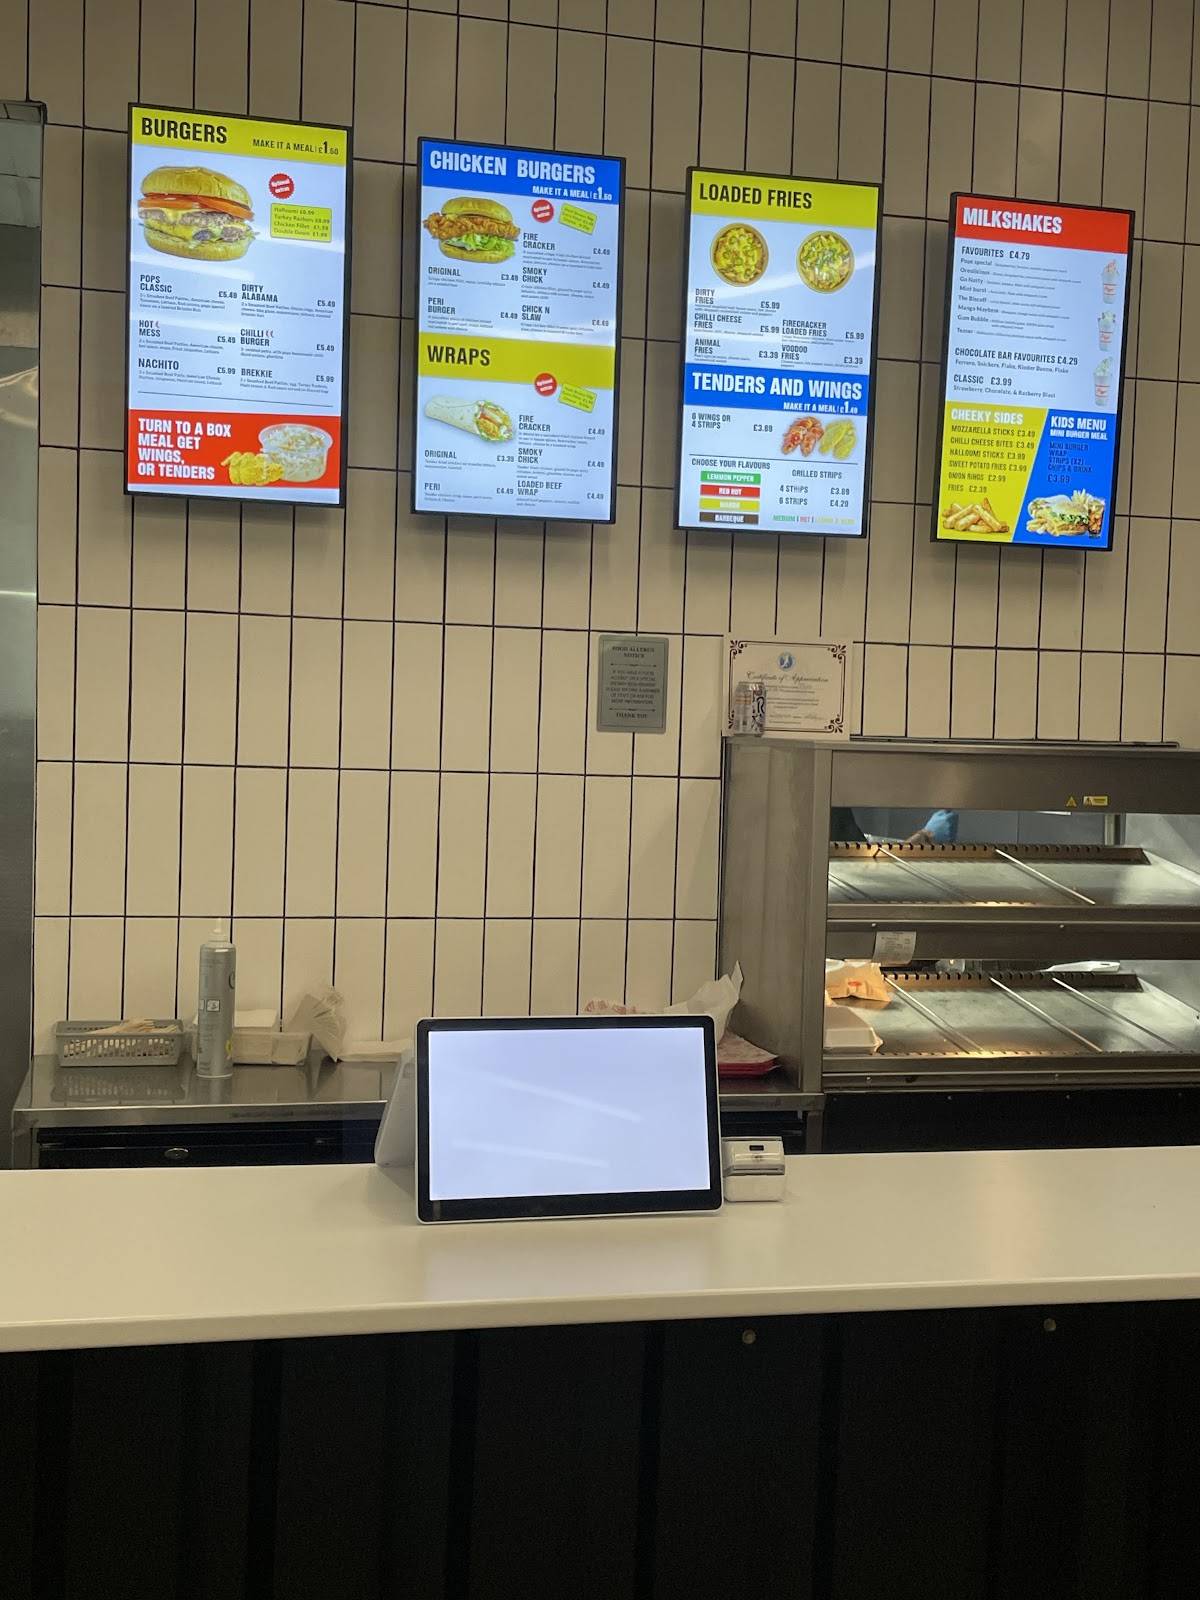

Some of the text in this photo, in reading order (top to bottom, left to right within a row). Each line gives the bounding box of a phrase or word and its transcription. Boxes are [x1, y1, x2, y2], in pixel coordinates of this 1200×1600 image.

[142, 117, 227, 144] BURGERS
[253, 139, 275, 149] MAKE
[277, 141, 284, 149] IT
[294, 144, 314, 152] MEAL
[430, 151, 596, 185] CHICKEN BURGERS
[533, 186, 553, 196] MAKE
[555, 188, 562, 196] IT
[570, 189, 589, 199] MEAL
[700, 183, 812, 210] LOADED FRIES
[963, 207, 1063, 234] MILKSHAKES
[523, 241, 556, 250] CRACKER
[962, 246, 1030, 260] FAVOURITES £4.79
[428, 267, 461, 277] ORIGINAL
[523, 267, 547, 276] SMOKY
[140, 275, 160, 284] POPS
[523, 275, 543, 284] CHICK
[140, 283, 237, 299] CLASSIC £5.49
[242, 284, 264, 293] DIRTY
[696, 288, 715, 296] DIRTY
[242, 292, 335, 308] ALABAMA £5.49
[428, 297, 444, 306] PERI
[695, 297, 714, 305] FRIES
[428, 305, 456, 315] BURGER
[522, 305, 543, 314] CHICK
[522, 313, 541, 321] SLAW
[695, 313, 742, 324] CHILLI CHEESE
[139, 320, 153, 328] HOT
[695, 321, 713, 329] FRIES
[783, 320, 827, 329] FIRECRACKER
[139, 329, 236, 344] MESS £5.49
[240, 329, 264, 338] CHILLI
[783, 328, 807, 336] LOADED
[241, 337, 335, 352] BURGER £5.49
[695, 339, 720, 347] ANIMAL
[782, 345, 808, 353] VOODOO
[428, 345, 491, 366] WRAPS
[955, 347, 1078, 365] CHOCOLATE BAR FAVOURITES £4.29
[138, 358, 179, 370] NACHITO
[241, 368, 272, 378] BREKKIE
[954, 374, 984, 384] CLASSIC
[692, 372, 862, 400] TENDERS AND WINGS
[784, 402, 803, 410] MAKE
[818, 404, 837, 413] MEAL
[519, 415, 534, 423] FIRE
[698, 414, 721, 422] WINGS
[951, 409, 1024, 425] CHEEKY SIDES
[138, 418, 231, 438] TURN TO A BOX
[519, 423, 551, 432] CRACKER
[698, 421, 721, 429] STRIPS
[1051, 416, 1106, 431] KIDS MENU
[952, 426, 991, 434] MOZZARELLA
[993, 428, 1014, 436] STICKS
[1050, 429, 1108, 440] MINI BURGER MEAL
[138, 433, 201, 450] MEAL GET
[138, 448, 185, 465] WINGS,
[425, 450, 457, 459] ORIGINAL
[518, 448, 543, 456] SMOKY
[950, 449, 1004, 459] HALLOUMI STICKS
[518, 456, 539, 464] CHICK
[692, 458, 771, 470] CHOOSE YOUR FLAVOURS
[138, 463, 215, 480] OR TENDERS
[792, 470, 842, 479] GRILLED STRIPS
[949, 472, 984, 481] ONION RINGS
[425, 483, 441, 491] PERI
[518, 480, 562, 490] LOADED BEEF
[518, 488, 539, 496] WRAP
